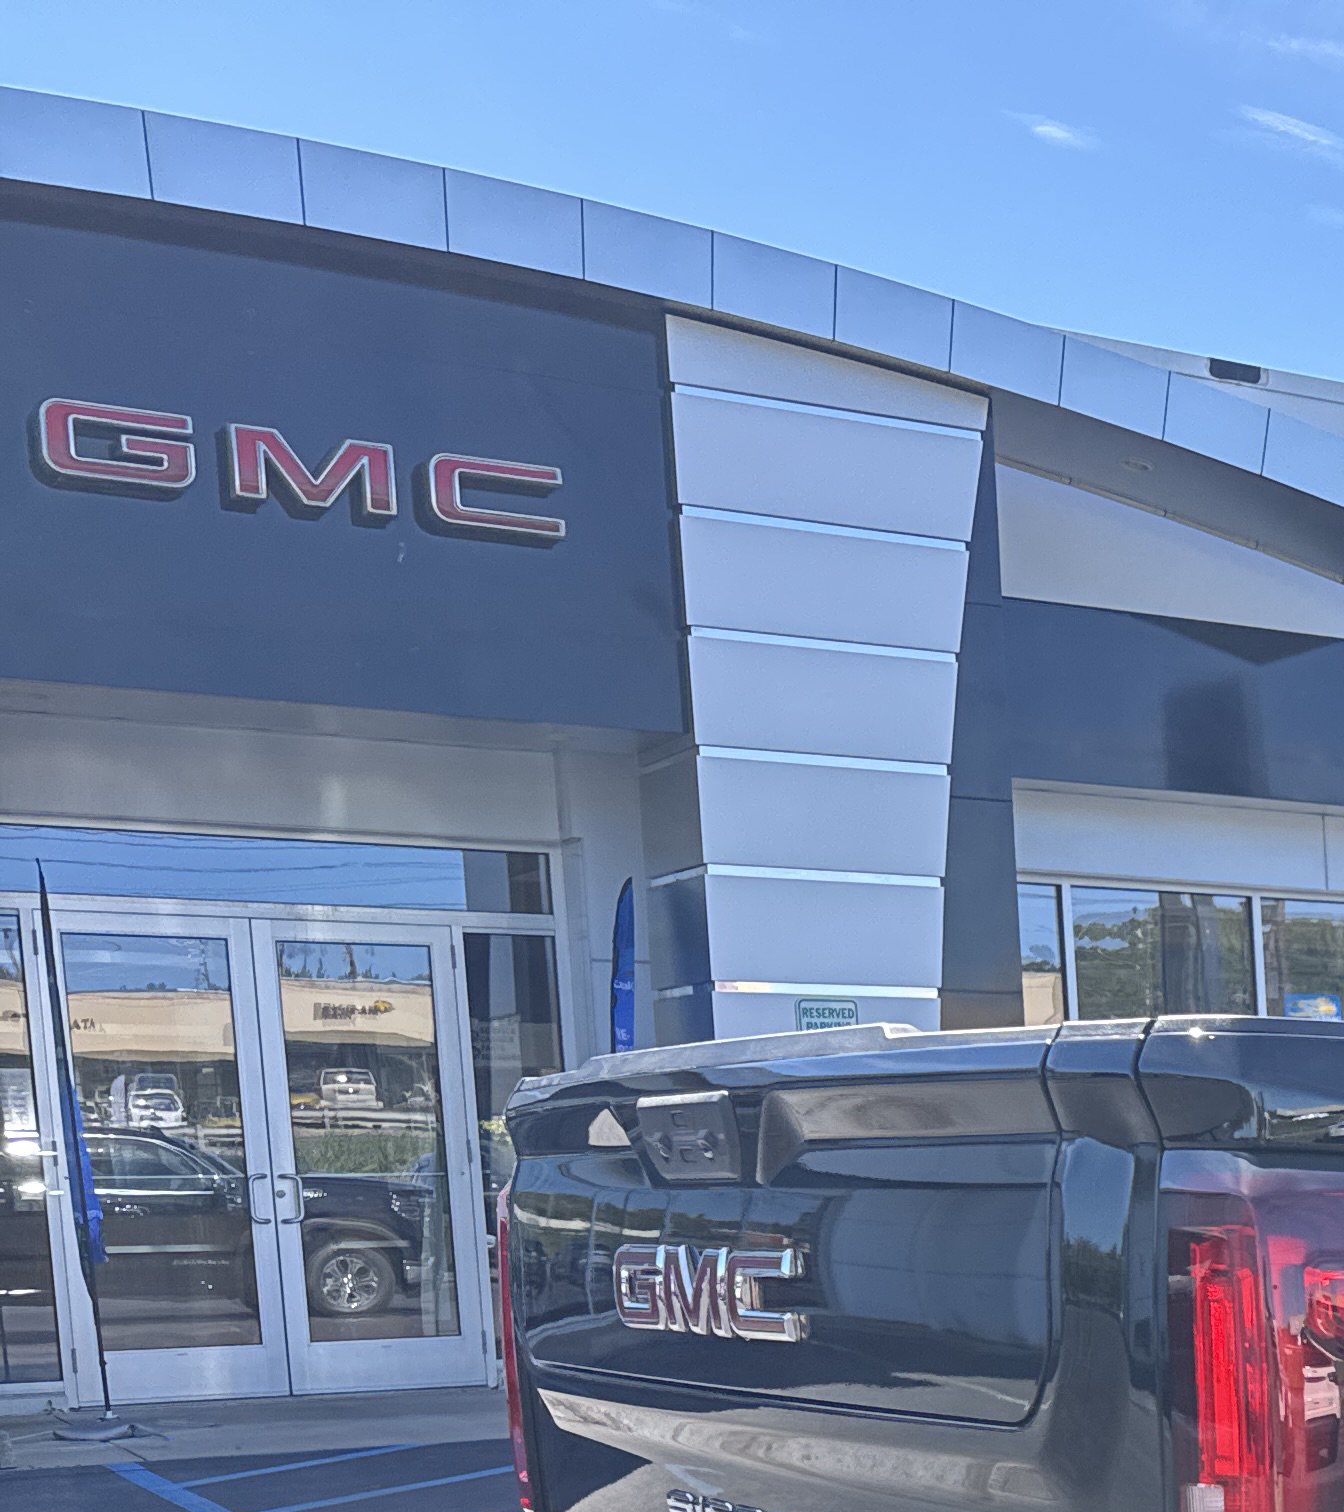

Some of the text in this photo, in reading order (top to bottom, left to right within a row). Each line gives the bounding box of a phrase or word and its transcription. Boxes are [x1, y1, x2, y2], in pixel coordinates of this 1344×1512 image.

[38, 397, 566, 538] GMC
[802, 1007, 855, 1019] RESERVED
[612, 1244, 803, 1342] GMC
